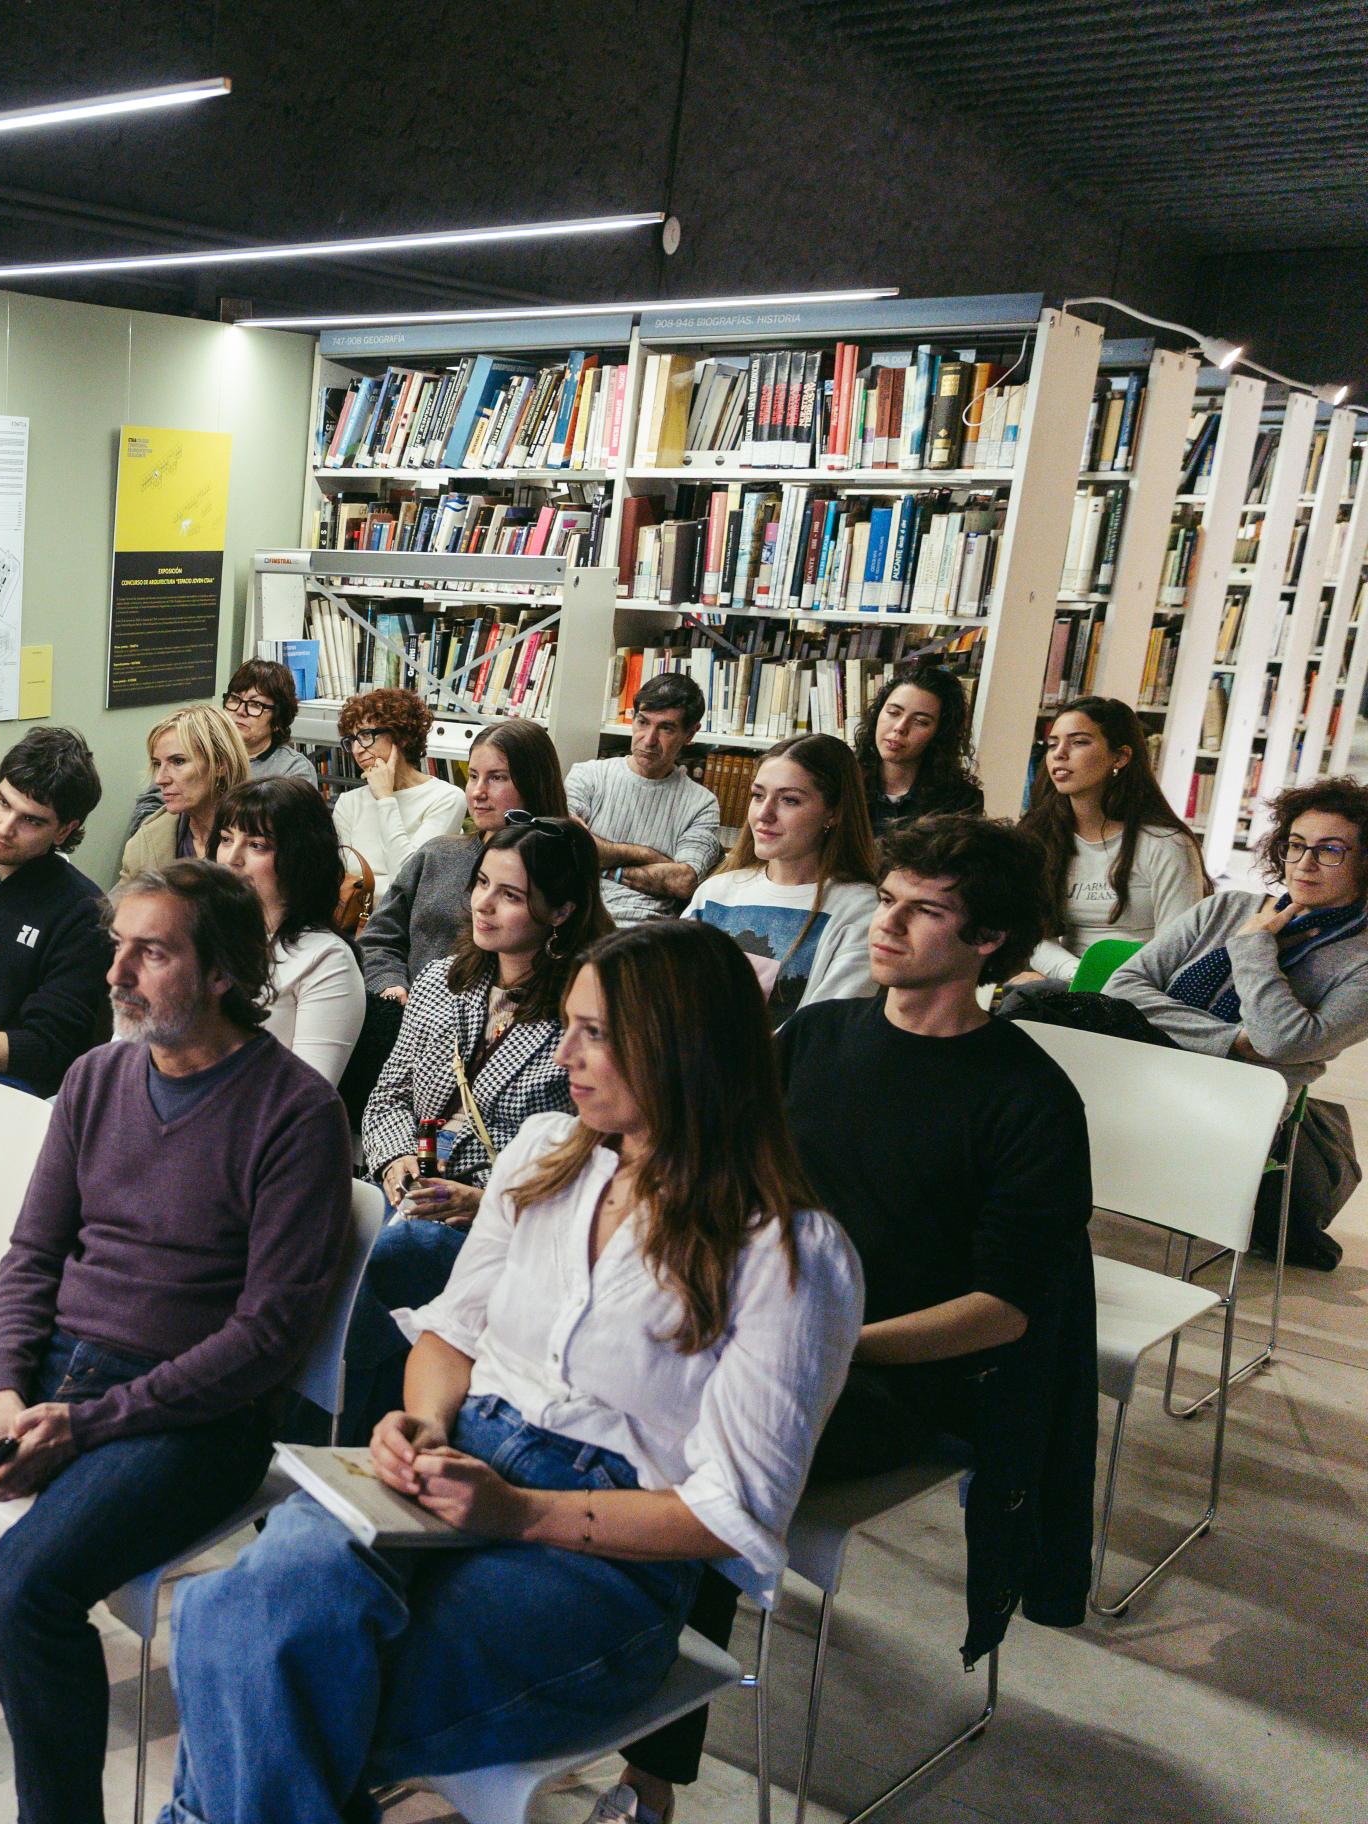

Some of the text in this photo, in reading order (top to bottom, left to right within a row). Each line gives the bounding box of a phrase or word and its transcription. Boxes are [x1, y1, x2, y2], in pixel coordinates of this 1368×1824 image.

[655, 318, 694, 328] 908-946
[757, 313, 801, 324] HISTORIA
[332, 332, 405, 346] 747-908 GEOGRAFÍA
[158, 567, 183, 575] EXPOSICIÓN
[892, 549, 903, 580] ALICANTE
[1085, 891, 1118, 901] JEANS
